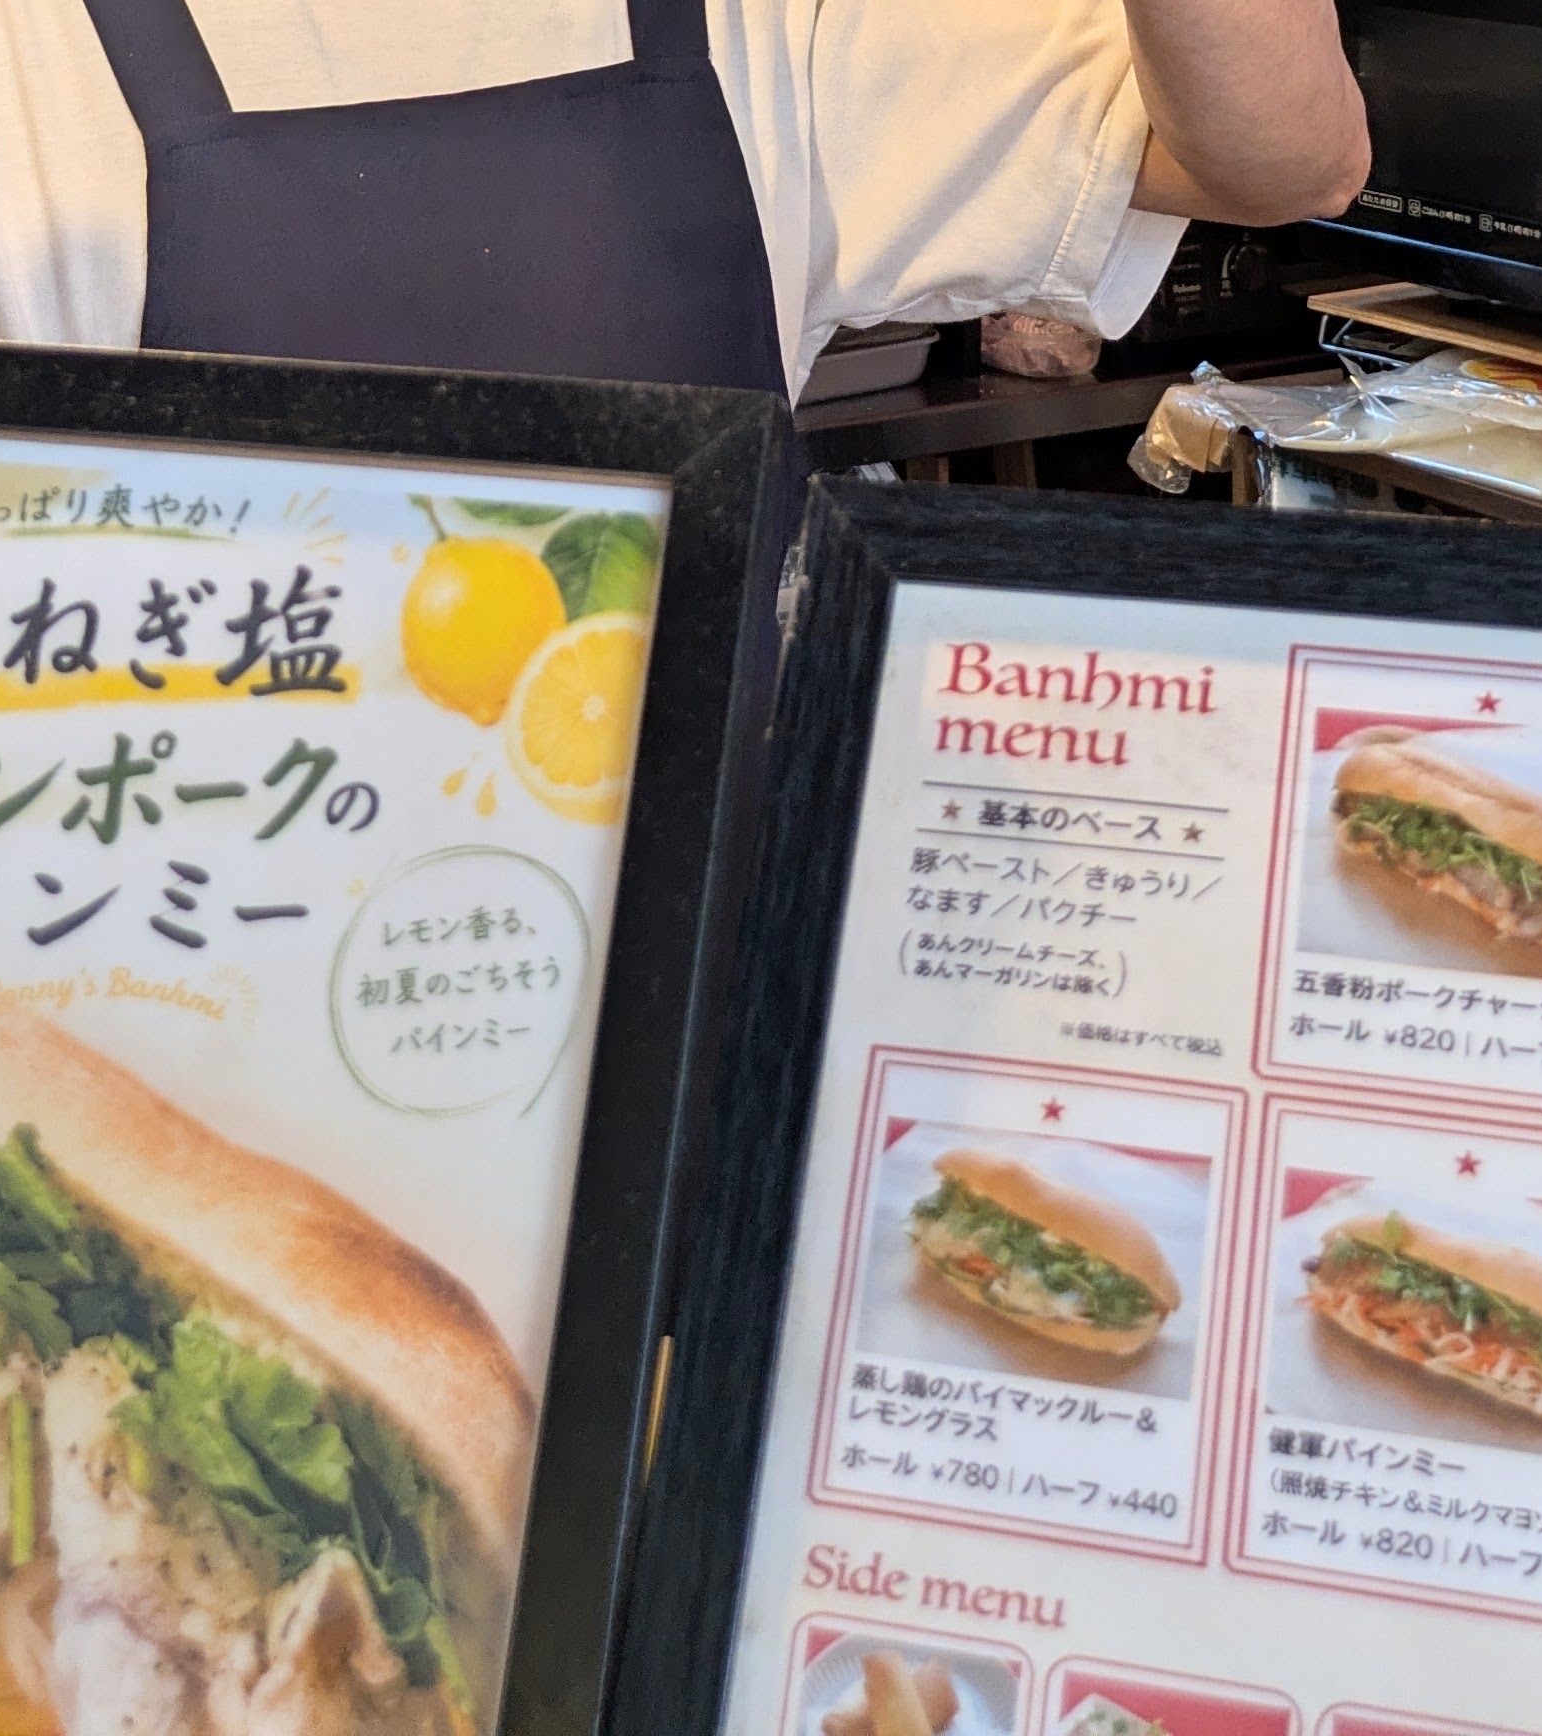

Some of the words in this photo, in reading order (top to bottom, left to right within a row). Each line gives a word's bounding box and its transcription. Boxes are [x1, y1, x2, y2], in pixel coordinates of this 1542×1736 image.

[938, 642, 1218, 714] Banhmi
[935, 715, 1131, 766] menu
[978, 799, 1162, 841] 基本のベース
[356, 956, 561, 1007] 初夏のごちそう
[1289, 1014, 1371, 1042] ホール
[841, 1444, 918, 1476] ホール
[1021, 1473, 1101, 1505] ハーフ
[1261, 1511, 1348, 1546] ホール
[802, 1543, 911, 1601] Side
[920, 1575, 1068, 1629] menu
